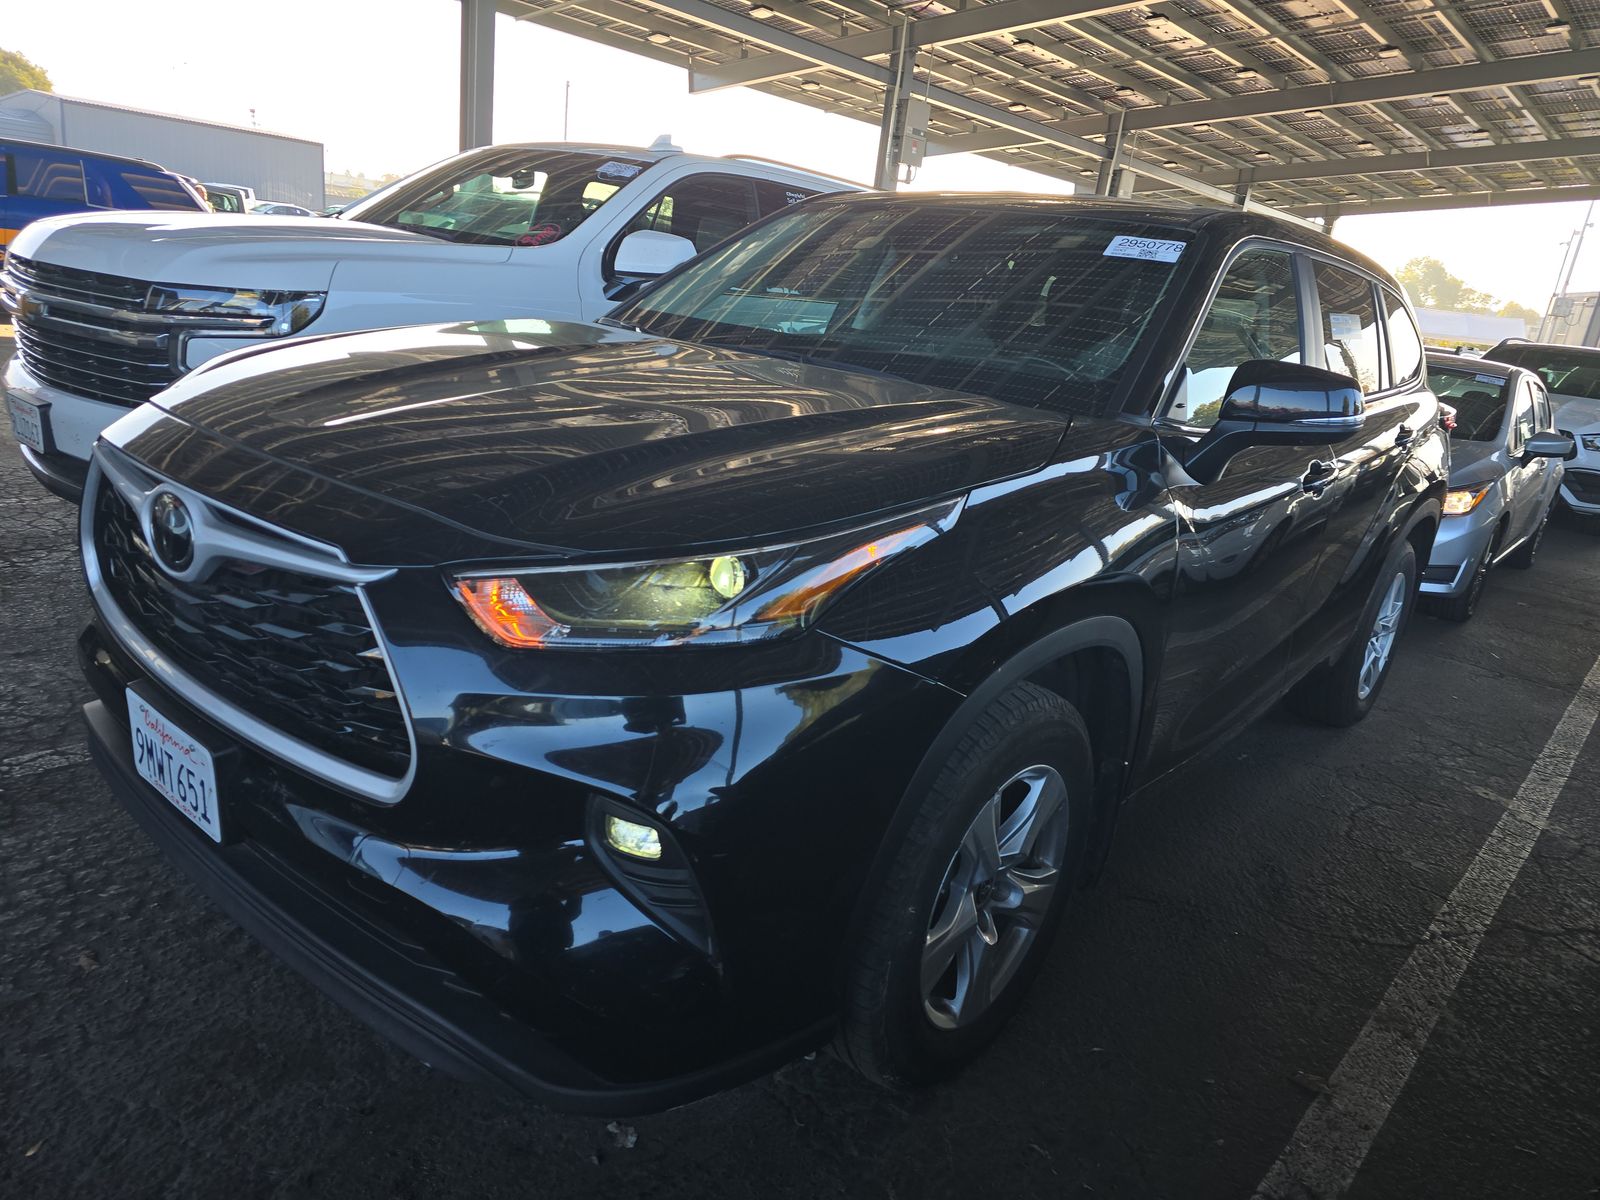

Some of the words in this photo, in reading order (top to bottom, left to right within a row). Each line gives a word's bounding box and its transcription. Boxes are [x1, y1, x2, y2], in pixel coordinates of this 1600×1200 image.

[1118, 238, 1184, 253] 2950778
[143, 708, 198, 765] California
[135, 727, 212, 825] 9MWT651
